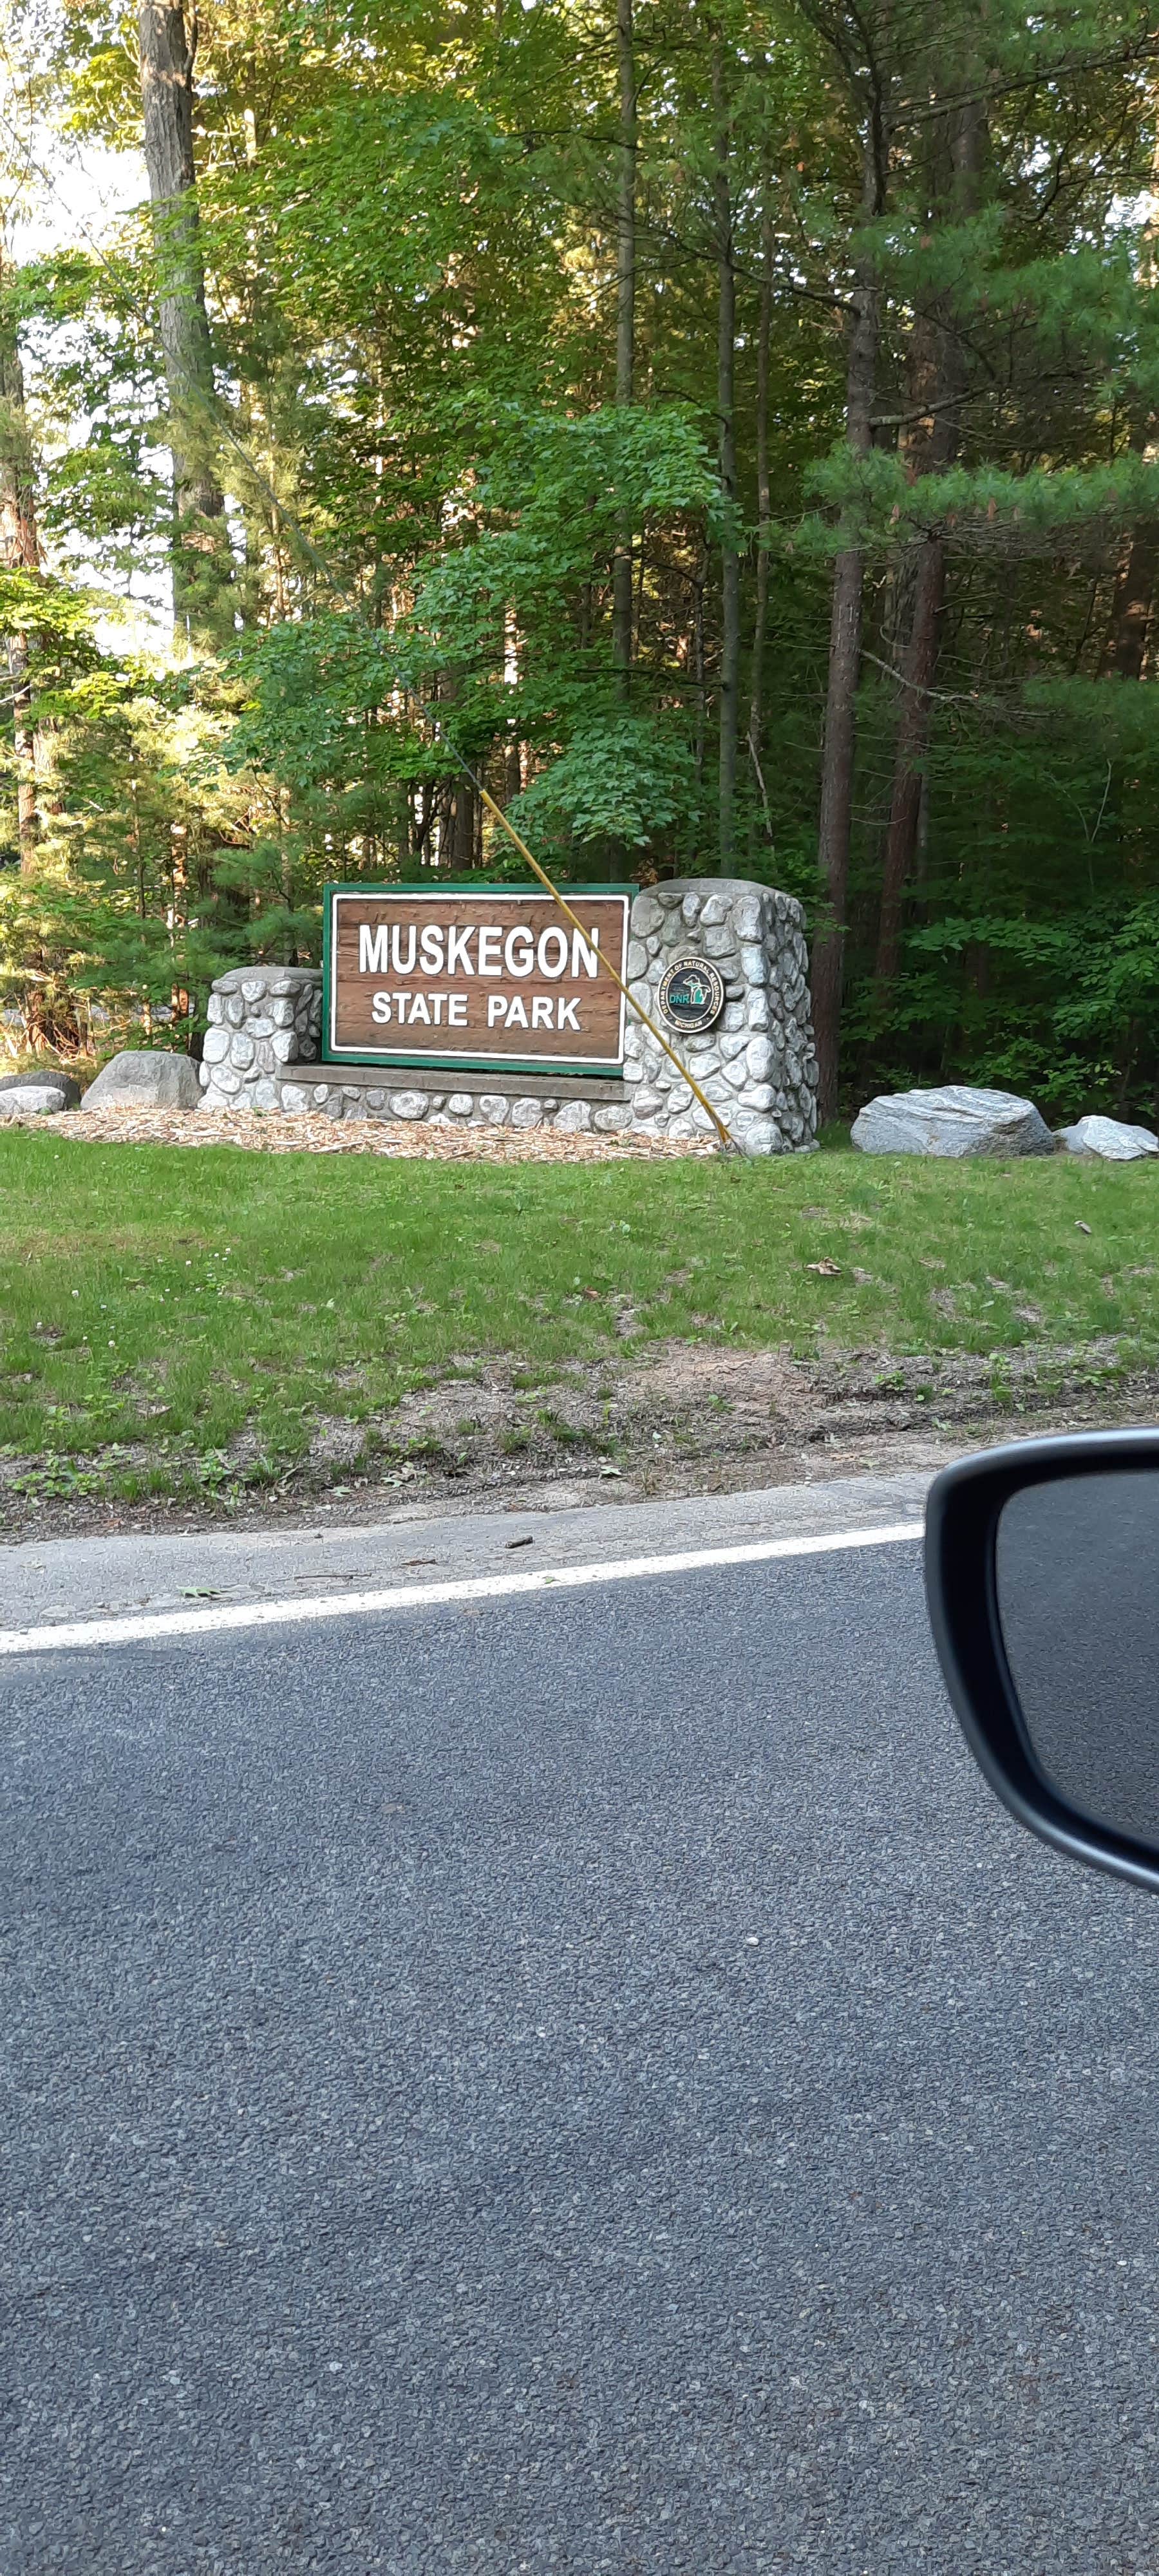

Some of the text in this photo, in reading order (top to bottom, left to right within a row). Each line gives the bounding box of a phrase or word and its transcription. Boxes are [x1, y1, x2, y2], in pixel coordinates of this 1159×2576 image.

[359, 924, 599, 978] MUSKEGON
[660, 969, 675, 1014] DEPARTMENT
[683, 961, 710, 974] NATURAL
[710, 972, 721, 1015] RESOURCES
[669, 994, 690, 1004] DNR
[372, 992, 582, 1030] STATE PARK
[675, 1019, 702, 1028] MICHIGAN
